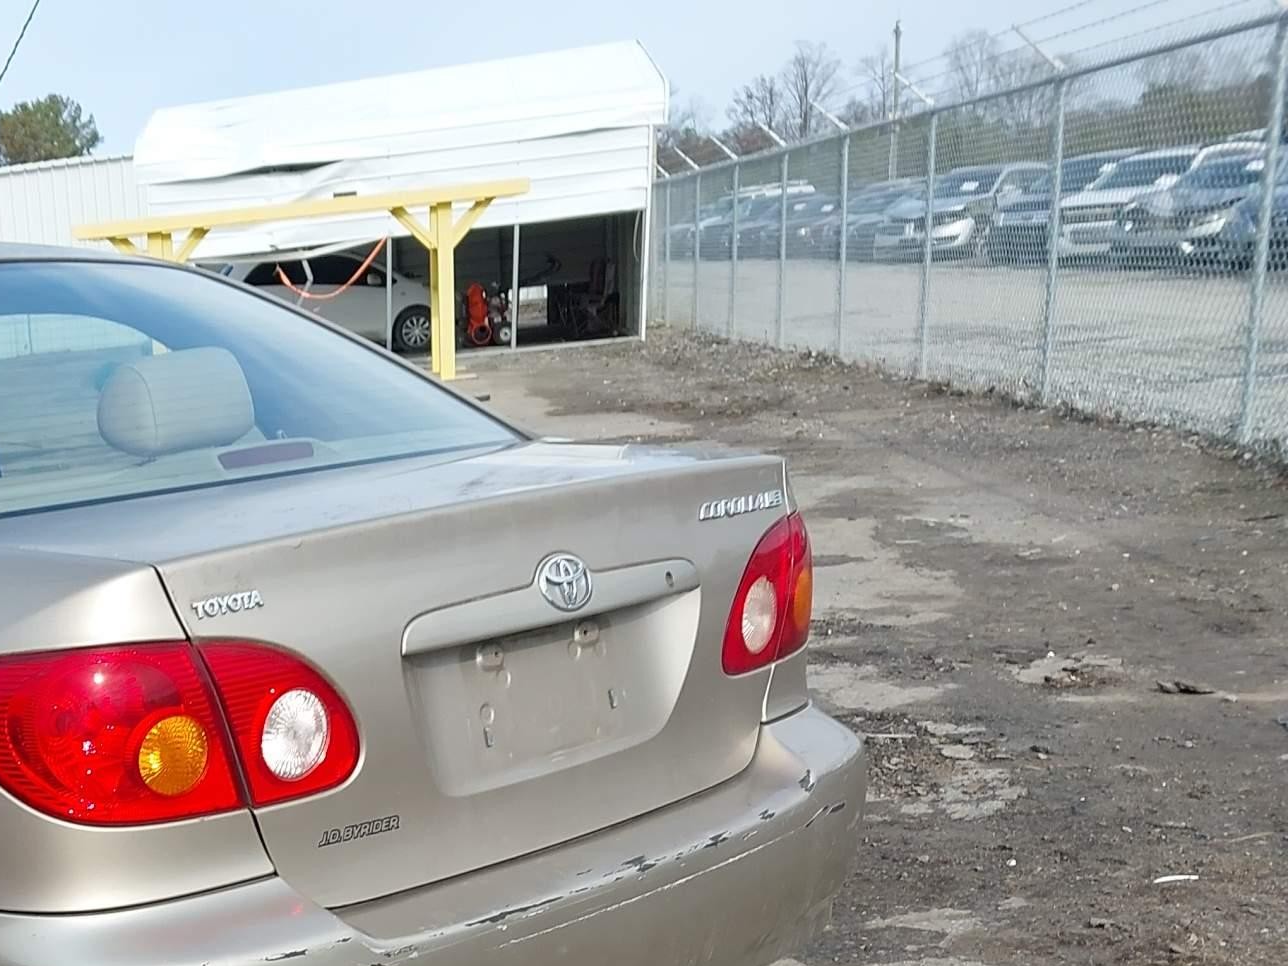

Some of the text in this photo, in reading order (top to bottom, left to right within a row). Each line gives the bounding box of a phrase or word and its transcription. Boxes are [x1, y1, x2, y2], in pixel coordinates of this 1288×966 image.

[698, 492, 764, 520] COROLLA
[191, 590, 264, 620] TOYOTA
[342, 814, 400, 842] BYRIDER
